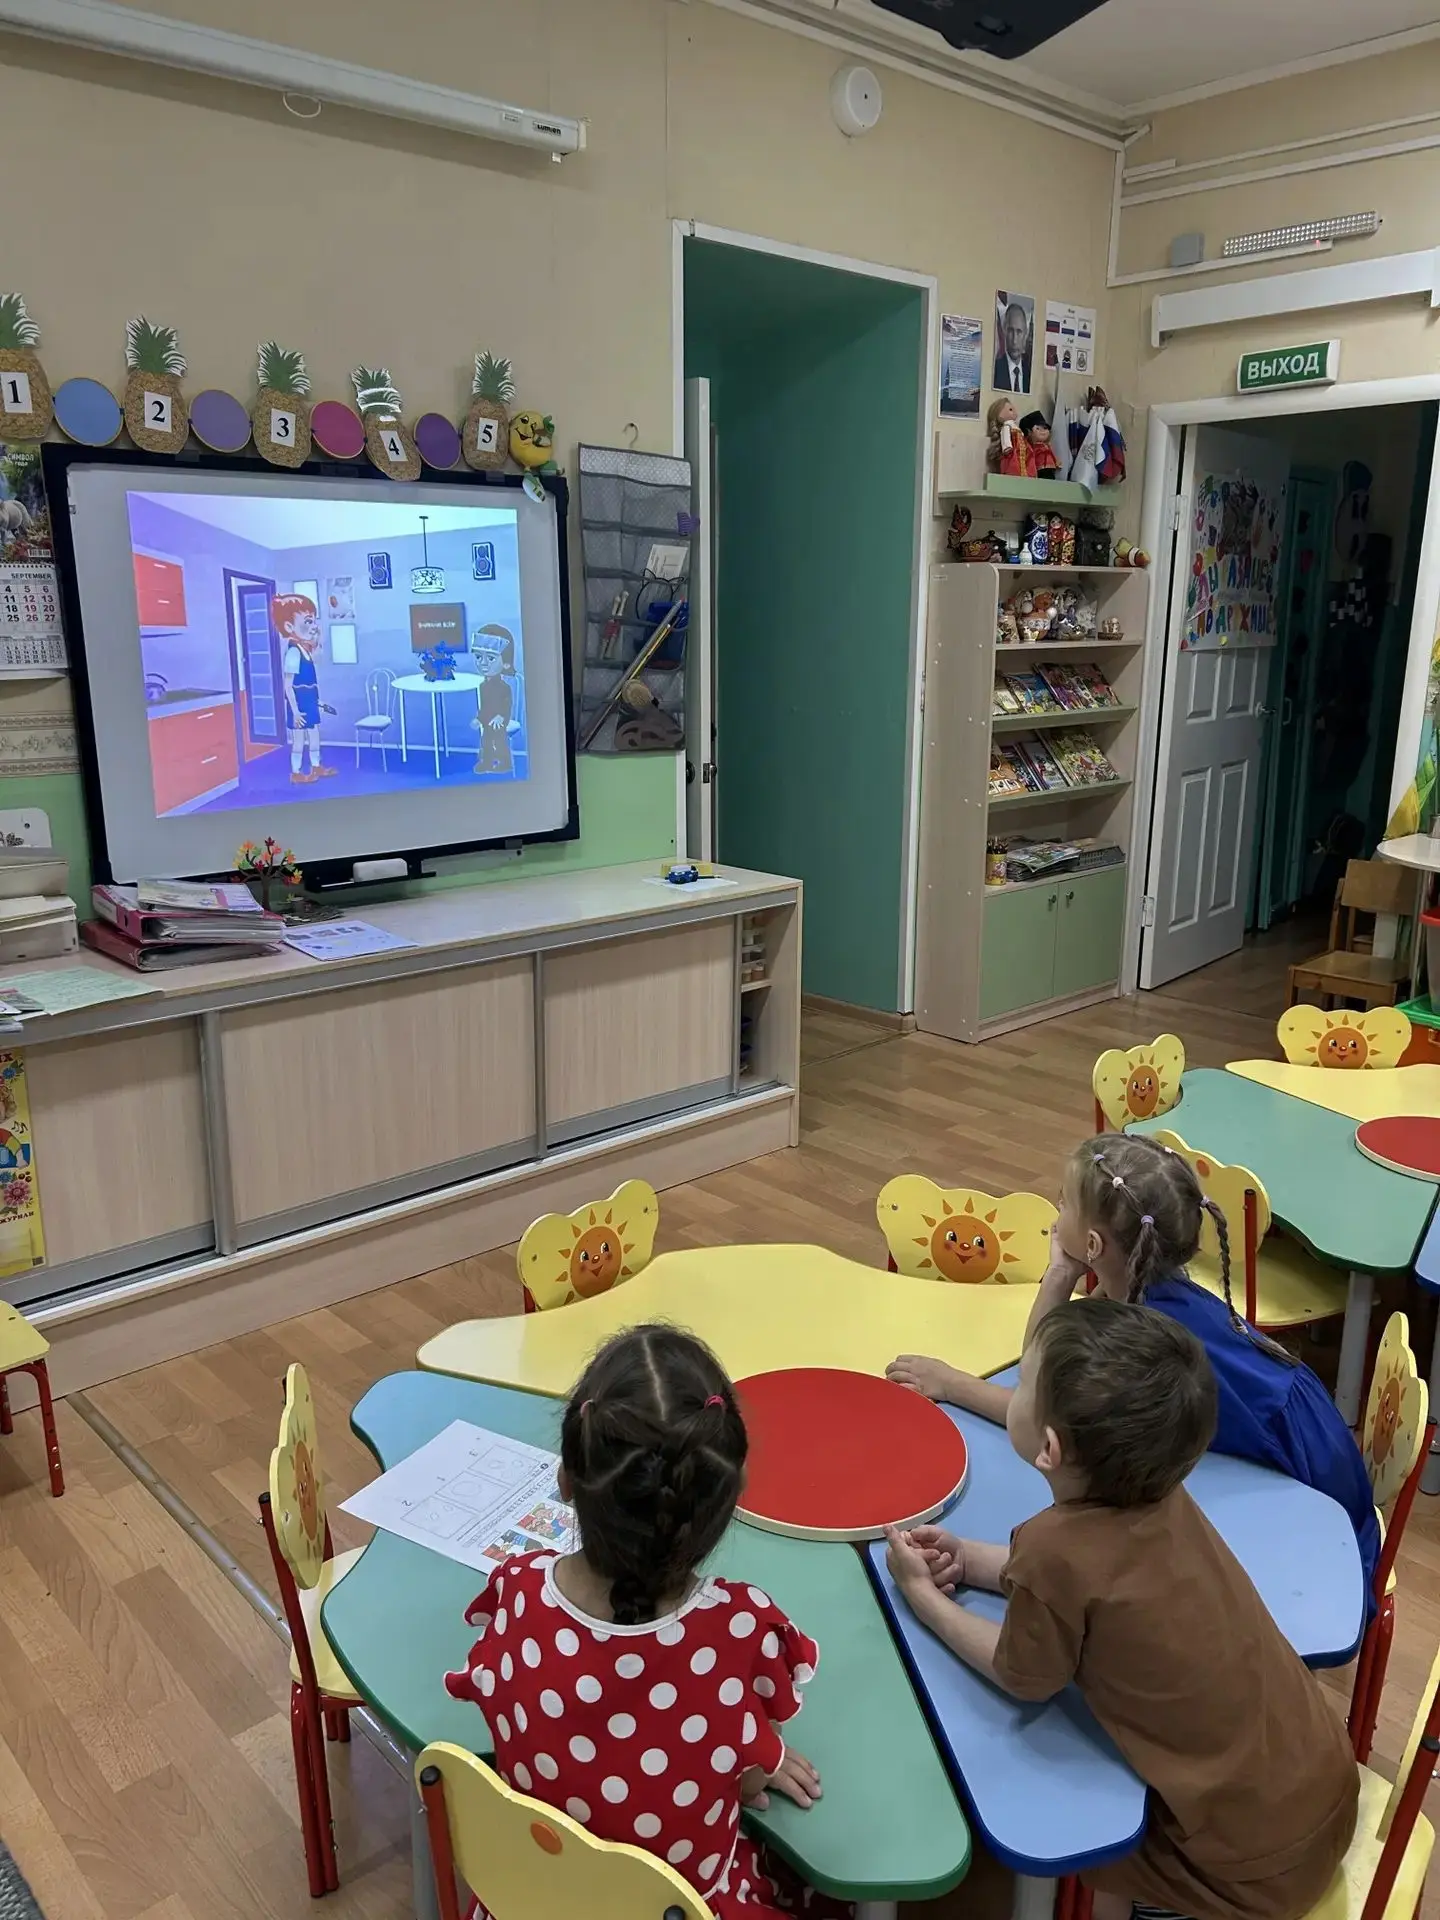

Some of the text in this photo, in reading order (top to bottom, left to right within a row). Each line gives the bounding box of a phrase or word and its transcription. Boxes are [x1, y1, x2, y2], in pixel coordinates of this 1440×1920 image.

[1247, 351, 1320, 380] ВЫХОД
[8, 379, 22, 404] 1
[151, 400, 165, 423] 2
[276, 417, 290, 438] 3
[481, 424, 494, 444] 5
[388, 437, 400, 456] 4
[11, 572, 53, 580] SEPTEMBER
[4, 595, 54, 603] 11 12 13
[6, 604, 55, 612] 18 19 20
[7, 614, 56, 622] 25 26 27
